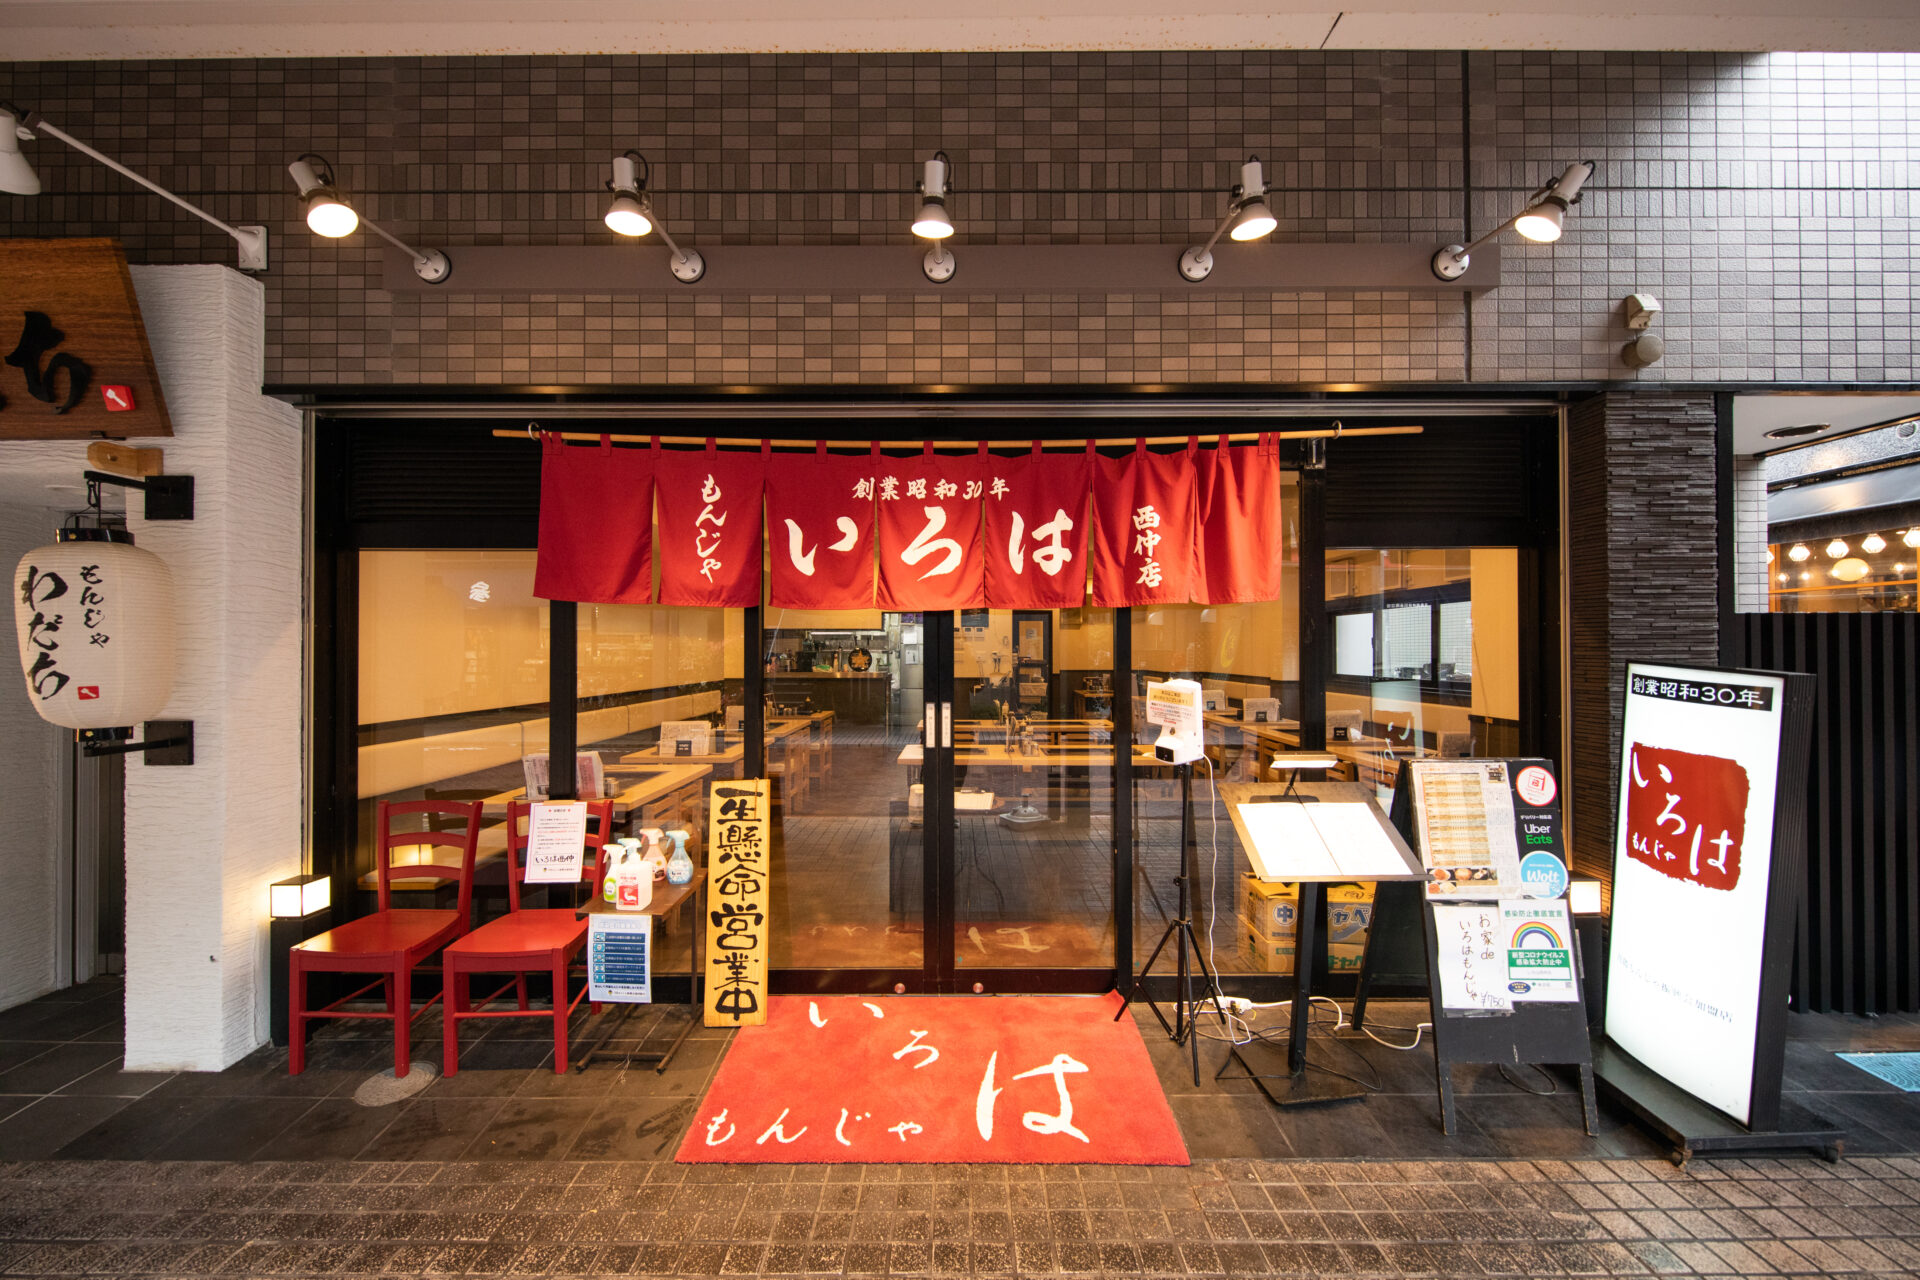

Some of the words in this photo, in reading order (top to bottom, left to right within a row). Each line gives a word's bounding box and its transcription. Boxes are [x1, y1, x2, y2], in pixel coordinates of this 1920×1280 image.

[852, 475, 1011, 502] 創業昭和30年
[694, 472, 730, 585] もんじゃ
[784, 504, 1075, 582] いろは
[1131, 504, 1164, 588] 西仲店
[21, 565, 70, 701] わだち
[79, 564, 110, 649] もんじゃ
[1632, 677, 1764, 708] 創業昭和30年
[1524, 823, 1551, 834] Uber
[1525, 834, 1553, 845] Eats
[1632, 750, 1734, 876] いろは
[1632, 832, 1677, 861] もんじゃ
[710, 787, 767, 1022] 一生懸命営業中
[1527, 869, 1560, 882] Wolt
[1459, 920, 1478, 1001] いろはもんじゃ
[1479, 914, 1495, 960] お家de
[808, 1000, 1091, 1144] いろは
[705, 1107, 925, 1147] もんじゃ
